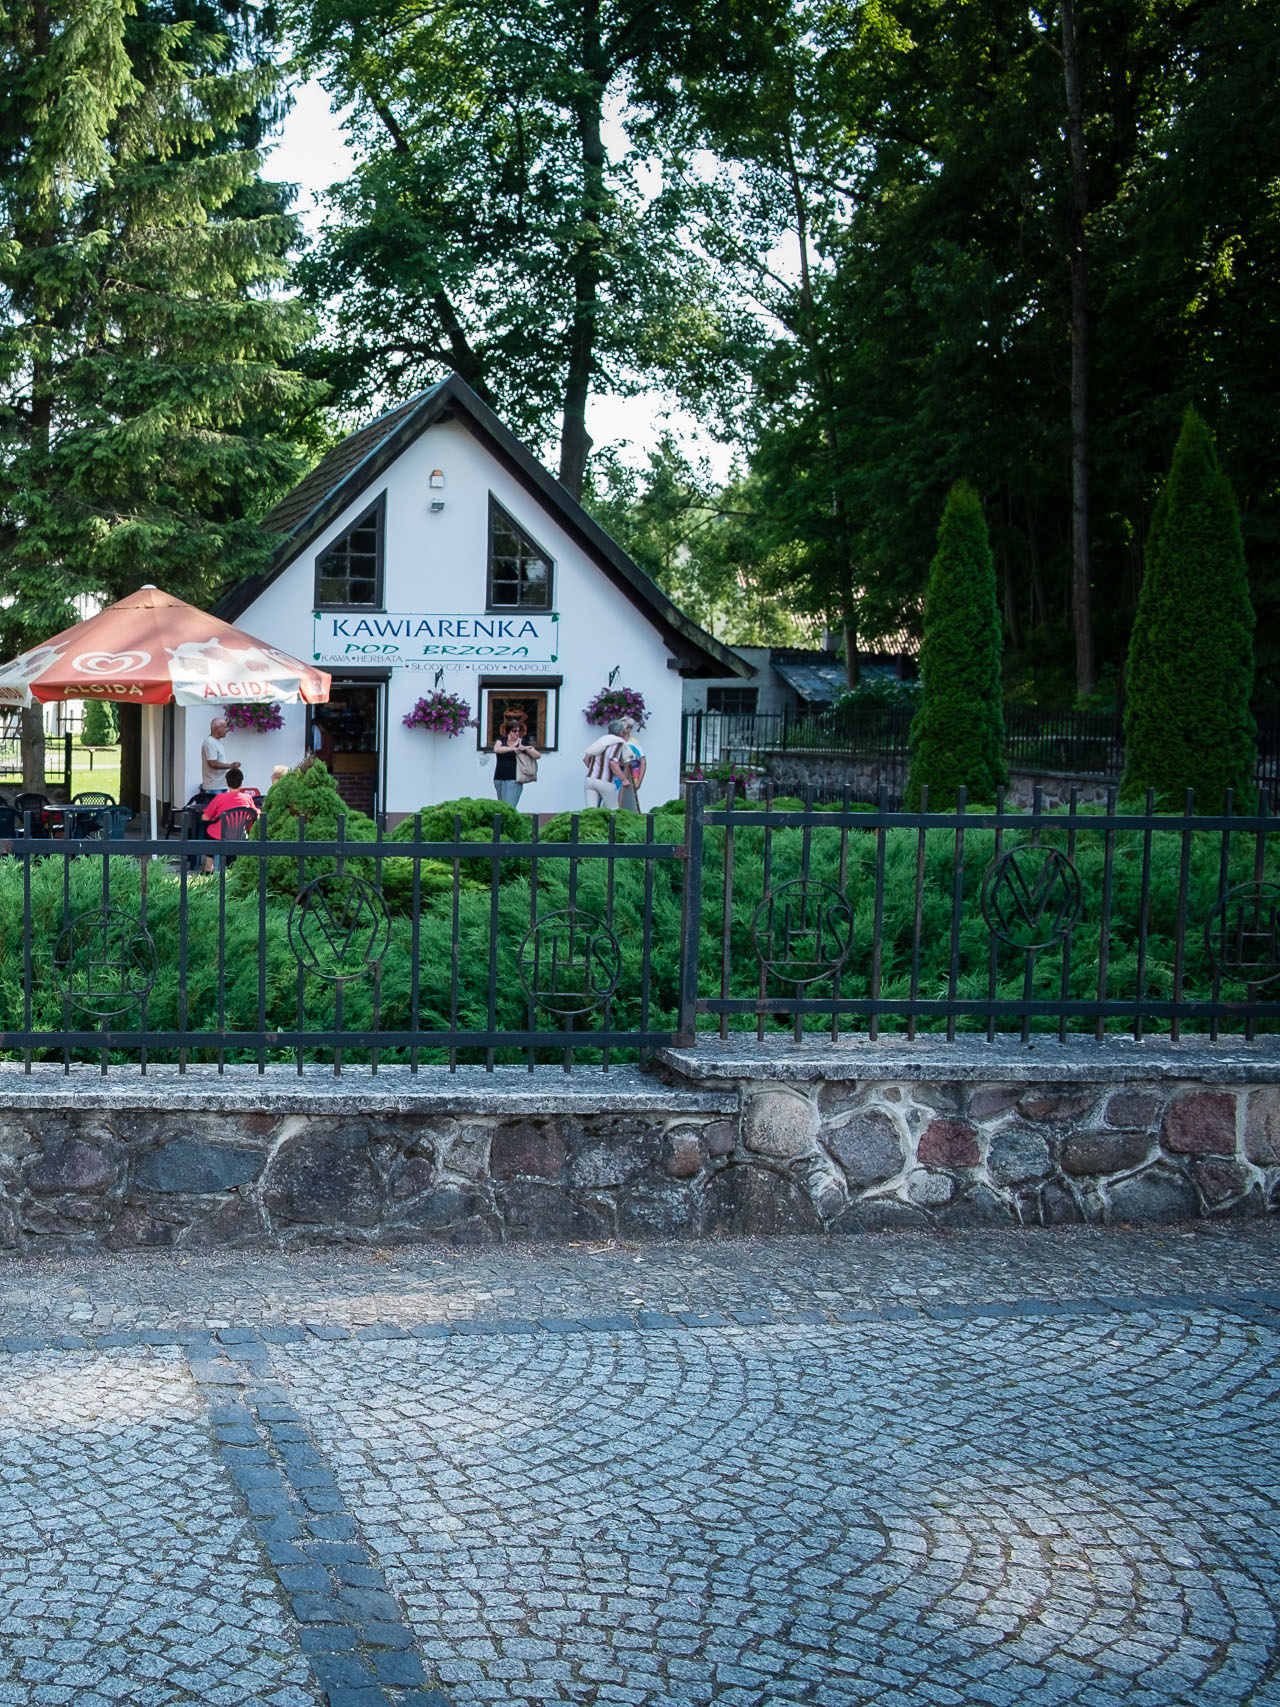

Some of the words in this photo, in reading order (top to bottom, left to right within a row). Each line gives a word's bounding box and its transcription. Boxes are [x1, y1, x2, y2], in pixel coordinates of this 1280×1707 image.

[332, 618, 540, 638] KAWIARENKA
[344, 643, 400, 656] POD
[320, 654, 352, 664] KAWA
[356, 654, 404, 664] HERBATA
[471, 663, 501, 672] LODY
[508, 663, 552, 672] NAPOJE
[63, 682, 145, 697] ALGIDA
[203, 680, 277, 699] ALGIDA
